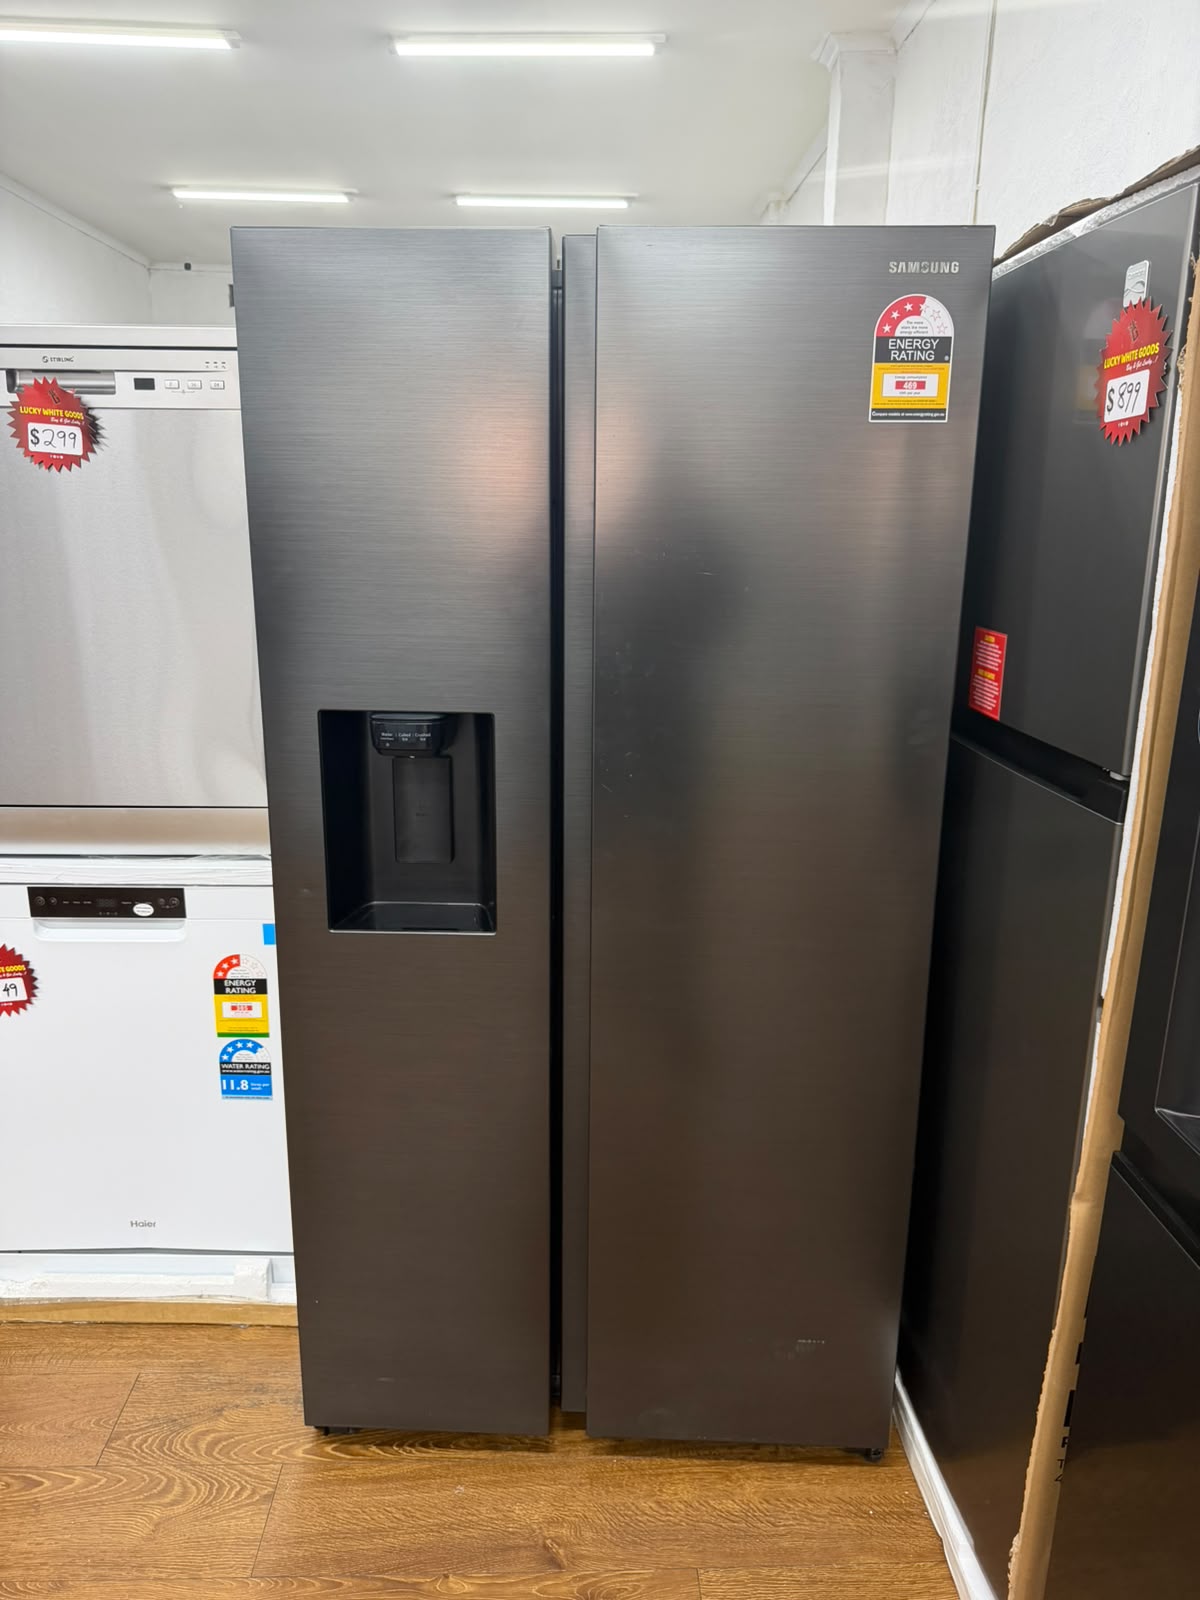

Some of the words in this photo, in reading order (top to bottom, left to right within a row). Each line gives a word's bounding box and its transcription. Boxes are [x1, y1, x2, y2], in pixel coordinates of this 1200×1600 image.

[888, 261, 960, 274] SAMSUNG
[888, 338, 940, 350] ENERGY
[890, 350, 935, 361] RATING
[1103, 355, 1120, 370] LUCKY
[1120, 349, 1138, 363] WHITE
[1138, 342, 1160, 358] GOODS
[1106, 381, 1142, 414] $899
[19, 405, 41, 414] LUCKY
[42, 408, 64, 417] WHITE
[64, 410, 85, 420] GOODS
[30, 428, 77, 449] $299
[223, 979, 257, 987] ENERGY
[222, 1079, 249, 1091] 11.8
[130, 1219, 157, 1228] Haier
